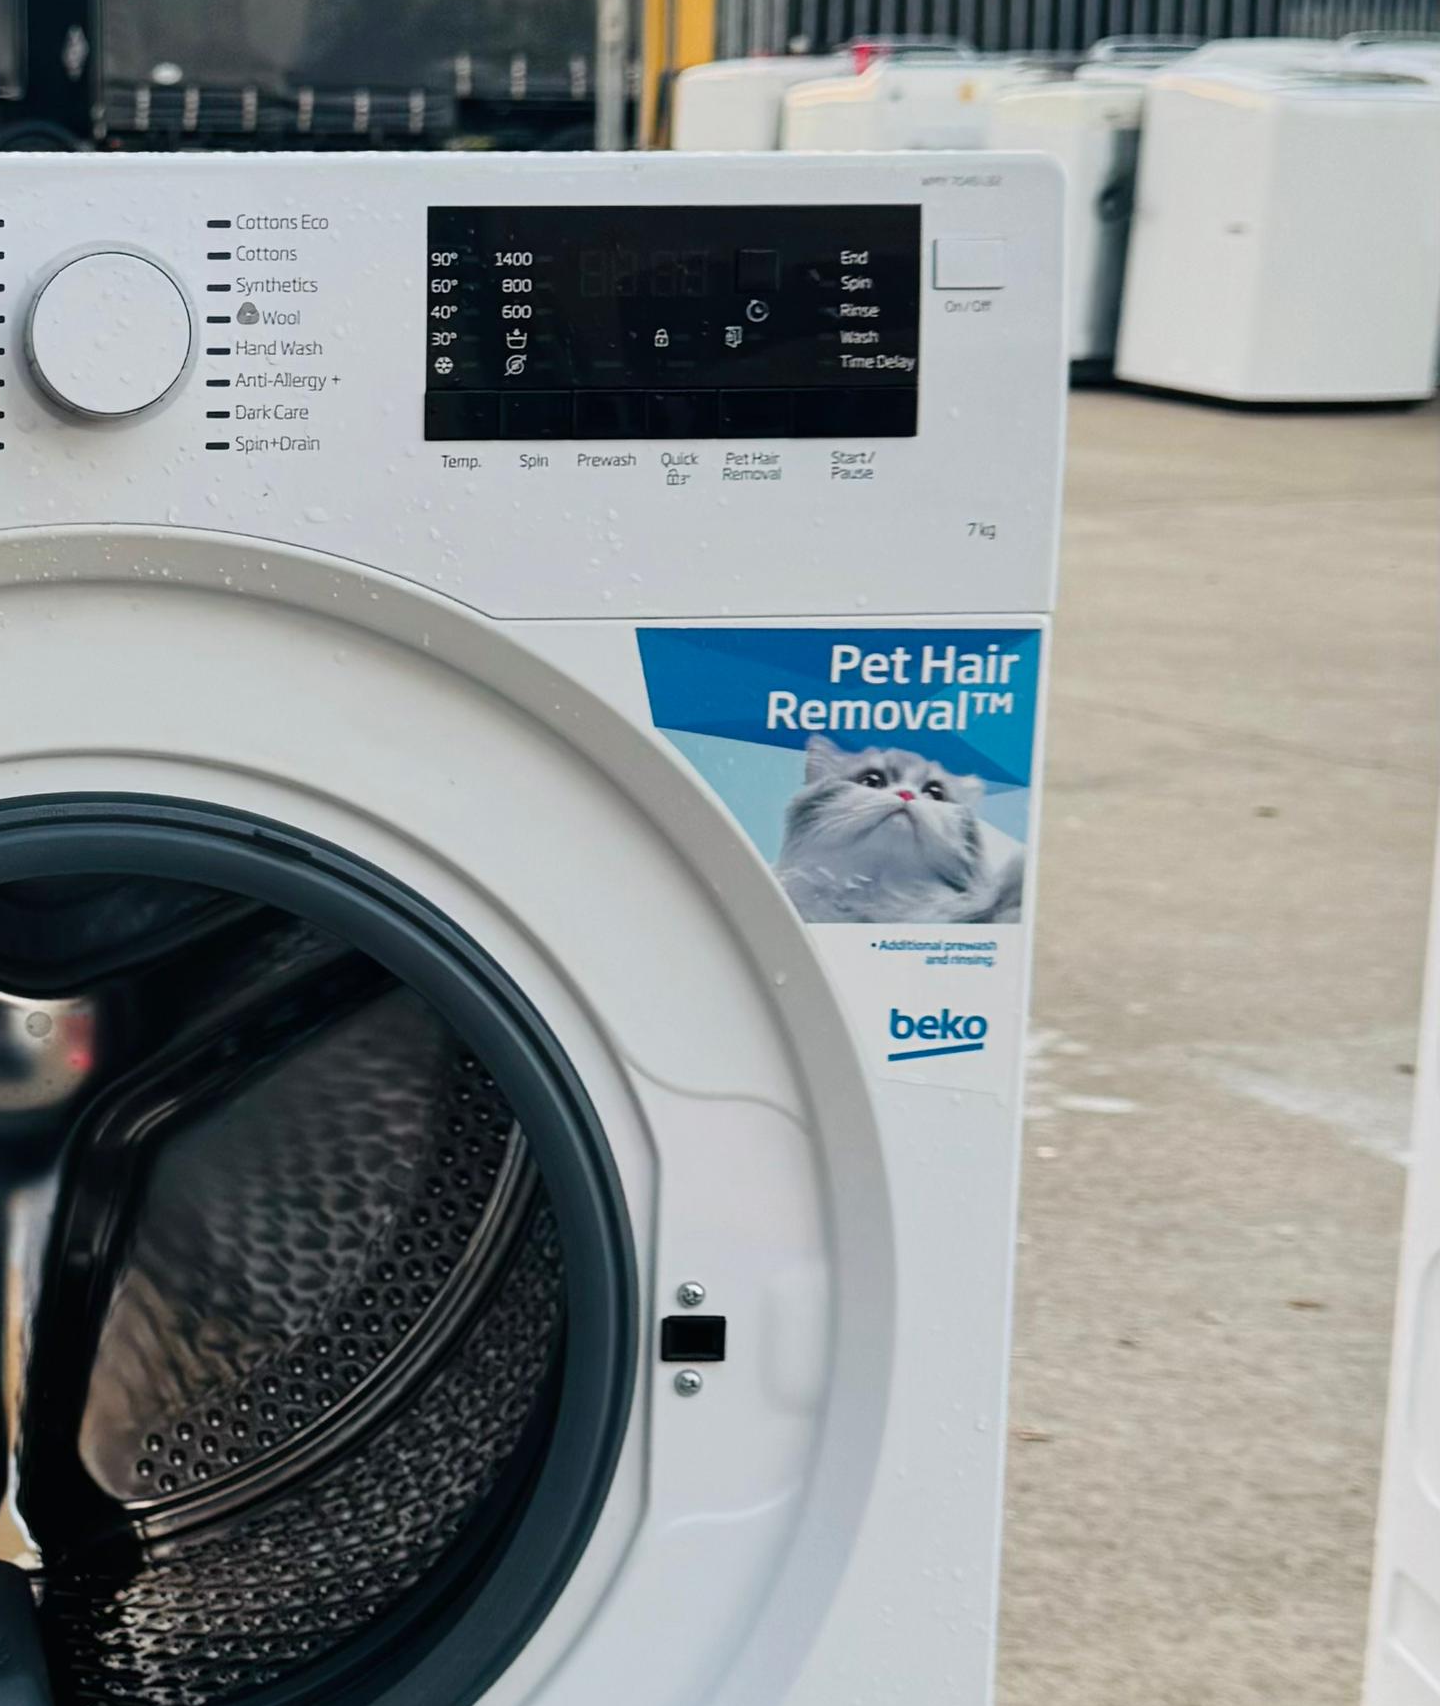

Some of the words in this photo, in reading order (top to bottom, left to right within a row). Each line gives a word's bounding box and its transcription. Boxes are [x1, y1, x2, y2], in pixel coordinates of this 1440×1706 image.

[237, 214, 297, 229] Cottons
[302, 214, 328, 229] Eco
[236, 246, 297, 261] Cottons
[494, 252, 533, 267] 1400
[840, 250, 869, 265] End
[236, 277, 318, 296] Synthetics
[431, 279, 458, 293] 60°
[502, 279, 532, 293] 800
[840, 275, 873, 292] Spin
[263, 311, 300, 325] Wool
[431, 305, 458, 319] 40°
[502, 305, 532, 319] 600
[839, 303, 880, 318] Rinse
[840, 330, 879, 344] Wash
[236, 341, 276, 355] Hand
[281, 341, 322, 355] Wash
[840, 355, 874, 369] Time
[876, 355, 916, 372] Delay
[235, 373, 326, 391] Anti-Allergy
[236, 405, 271, 420] Dark
[274, 405, 308, 420] Care
[235, 436, 320, 454] Spin+Drain
[441, 455, 481, 470] Temp.
[520, 454, 548, 469] Spin
[578, 453, 636, 467] Prewash
[661, 453, 698, 468] Quick
[726, 452, 748, 465] Pet
[752, 453, 780, 465] Hair
[723, 468, 781, 480] Removal
[832, 467, 873, 479] Pause
[831, 645, 911, 684] Pet
[921, 644, 1020, 684] Hair
[890, 1009, 987, 1039] beko
